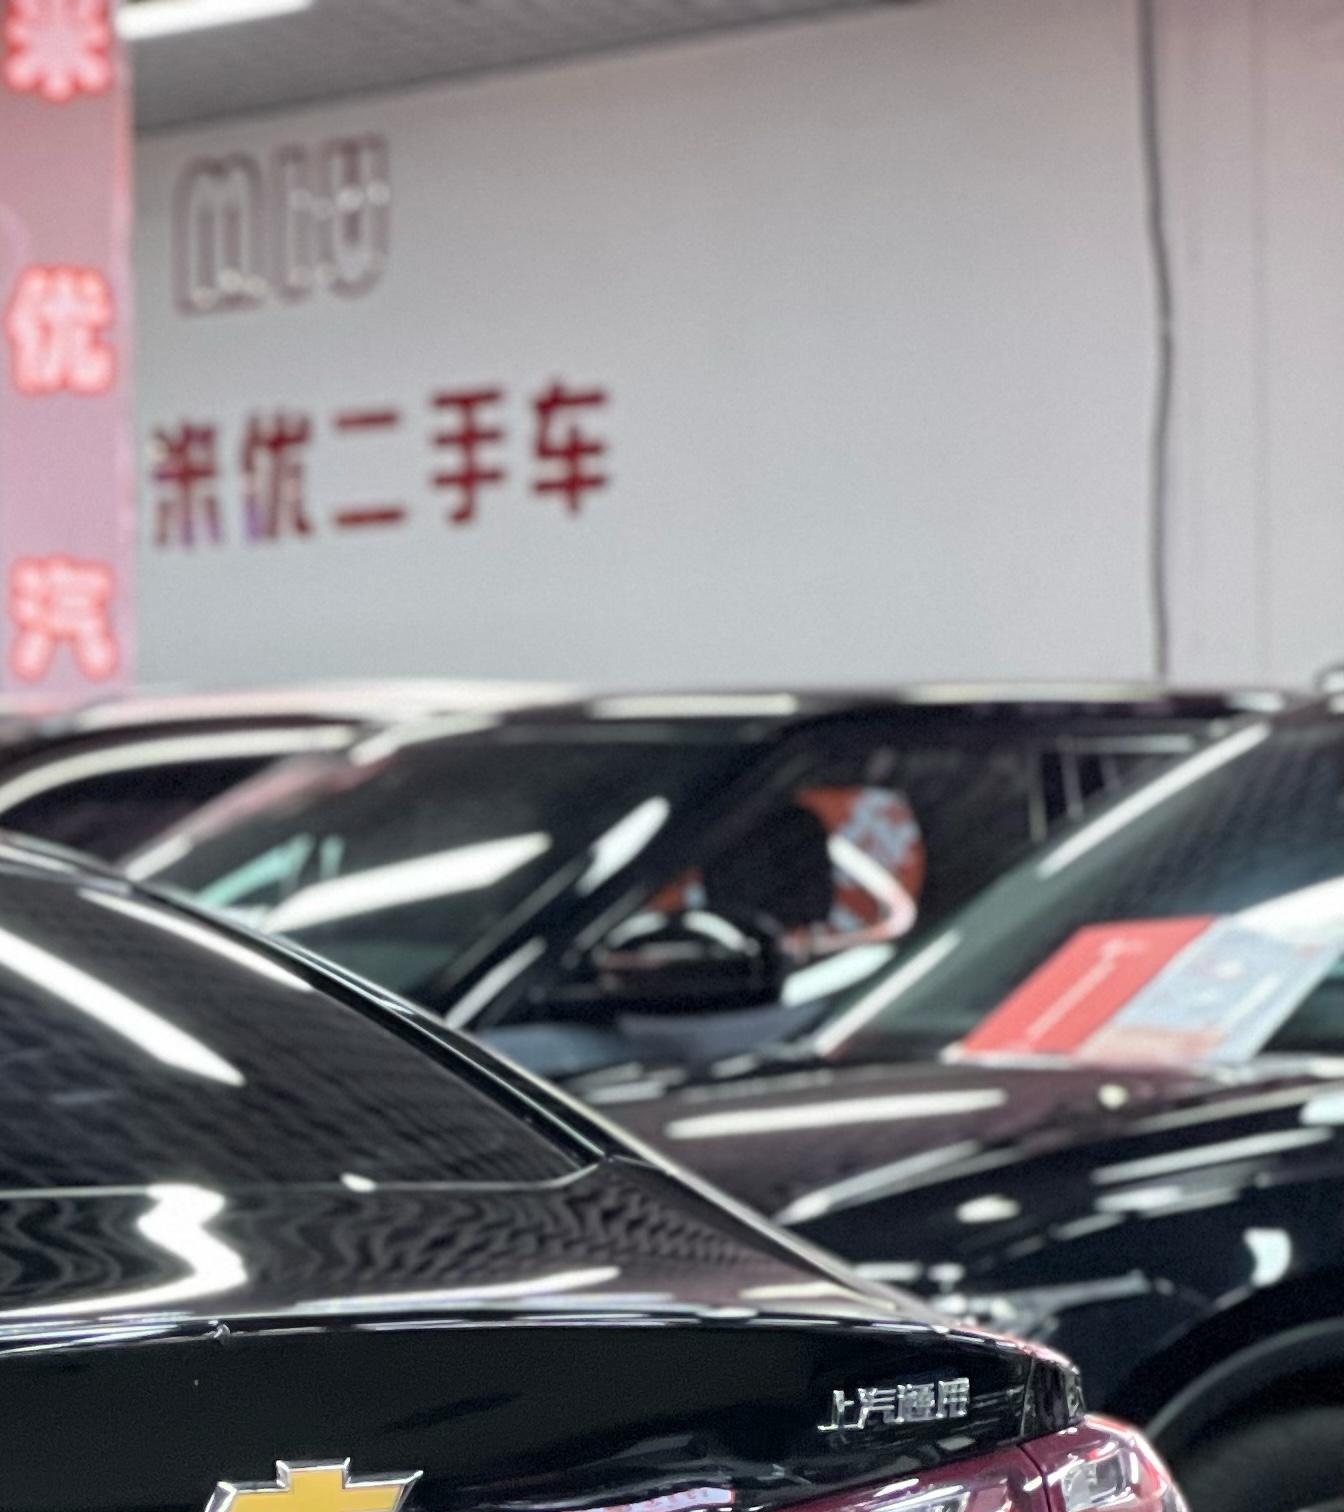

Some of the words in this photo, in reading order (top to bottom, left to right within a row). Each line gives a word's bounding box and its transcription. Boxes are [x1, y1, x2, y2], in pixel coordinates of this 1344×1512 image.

[151, 376, 607, 548] 米优二手车
